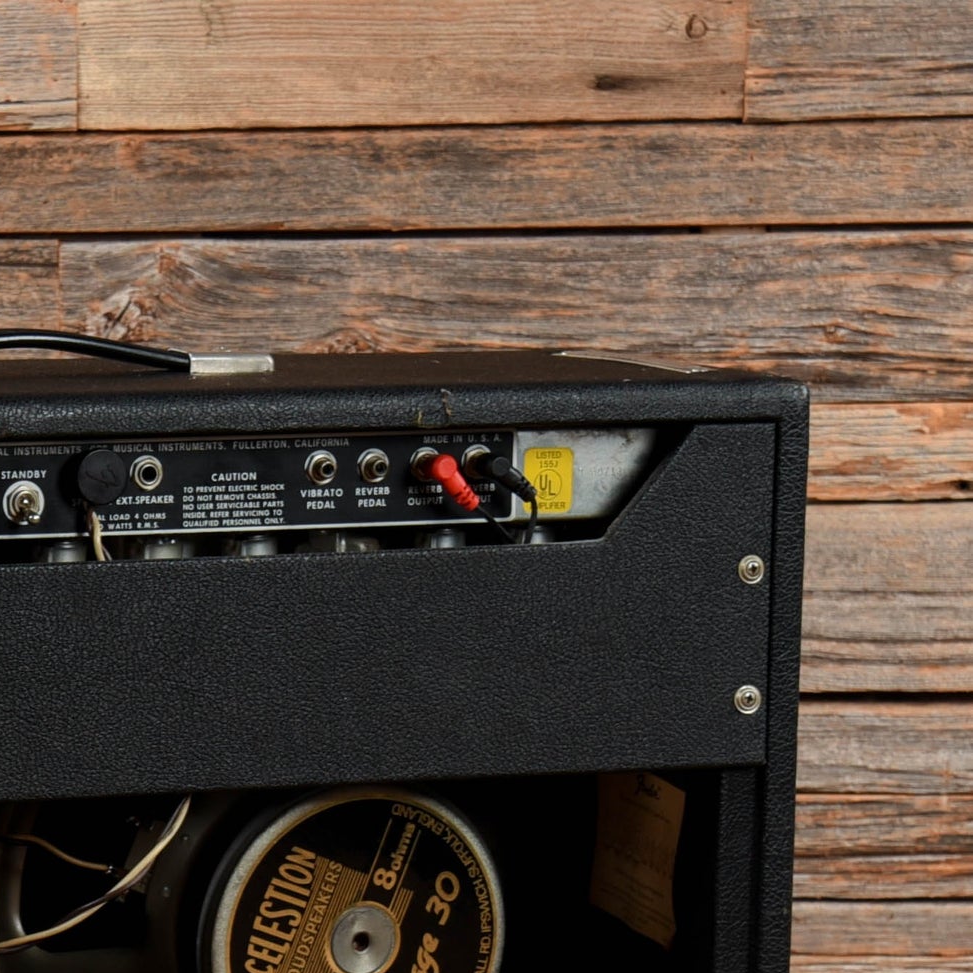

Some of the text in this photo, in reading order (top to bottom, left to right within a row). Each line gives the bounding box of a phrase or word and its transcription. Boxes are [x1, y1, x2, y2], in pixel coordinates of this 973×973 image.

[423, 434, 449, 443] MADE
[453, 434, 463, 443] IN
[113, 444, 153, 453] MUSICAL
[295, 438, 349, 448] CALIFORNIA
[536, 451, 562, 459] LISTED
[1, 470, 47, 480] STANDBY
[211, 472, 257, 482] CAUTION
[183, 483, 285, 494] TO PREVENT ELECTRIC SHOCK
[300, 488, 344, 498] VIBRATO
[355, 486, 390, 496] REVERB
[408, 485, 443, 495] REVERB
[182, 495, 194, 503] DO
[197, 494, 212, 502] NOT
[215, 493, 245, 501] REMOVE
[358, 498, 386, 508] PEDAL
[407, 496, 443, 505] OUTPUT
[182, 499, 285, 511] NO USER SERVICEABLE PARTS
[306, 501, 336, 510] PEDAL
[143, 512, 166, 520] OHMS
[210, 510, 229, 519] REFER
[232, 509, 270, 518] SERVICING
[108, 522, 133, 530] WATTS
[182, 519, 219, 528] QUALIFIED
[222, 518, 262, 527] PERSONNEL
[390, 803, 445, 836] ENGLAND
[373, 822, 416, 890] 8 ohms
[425, 870, 461, 926] 30
